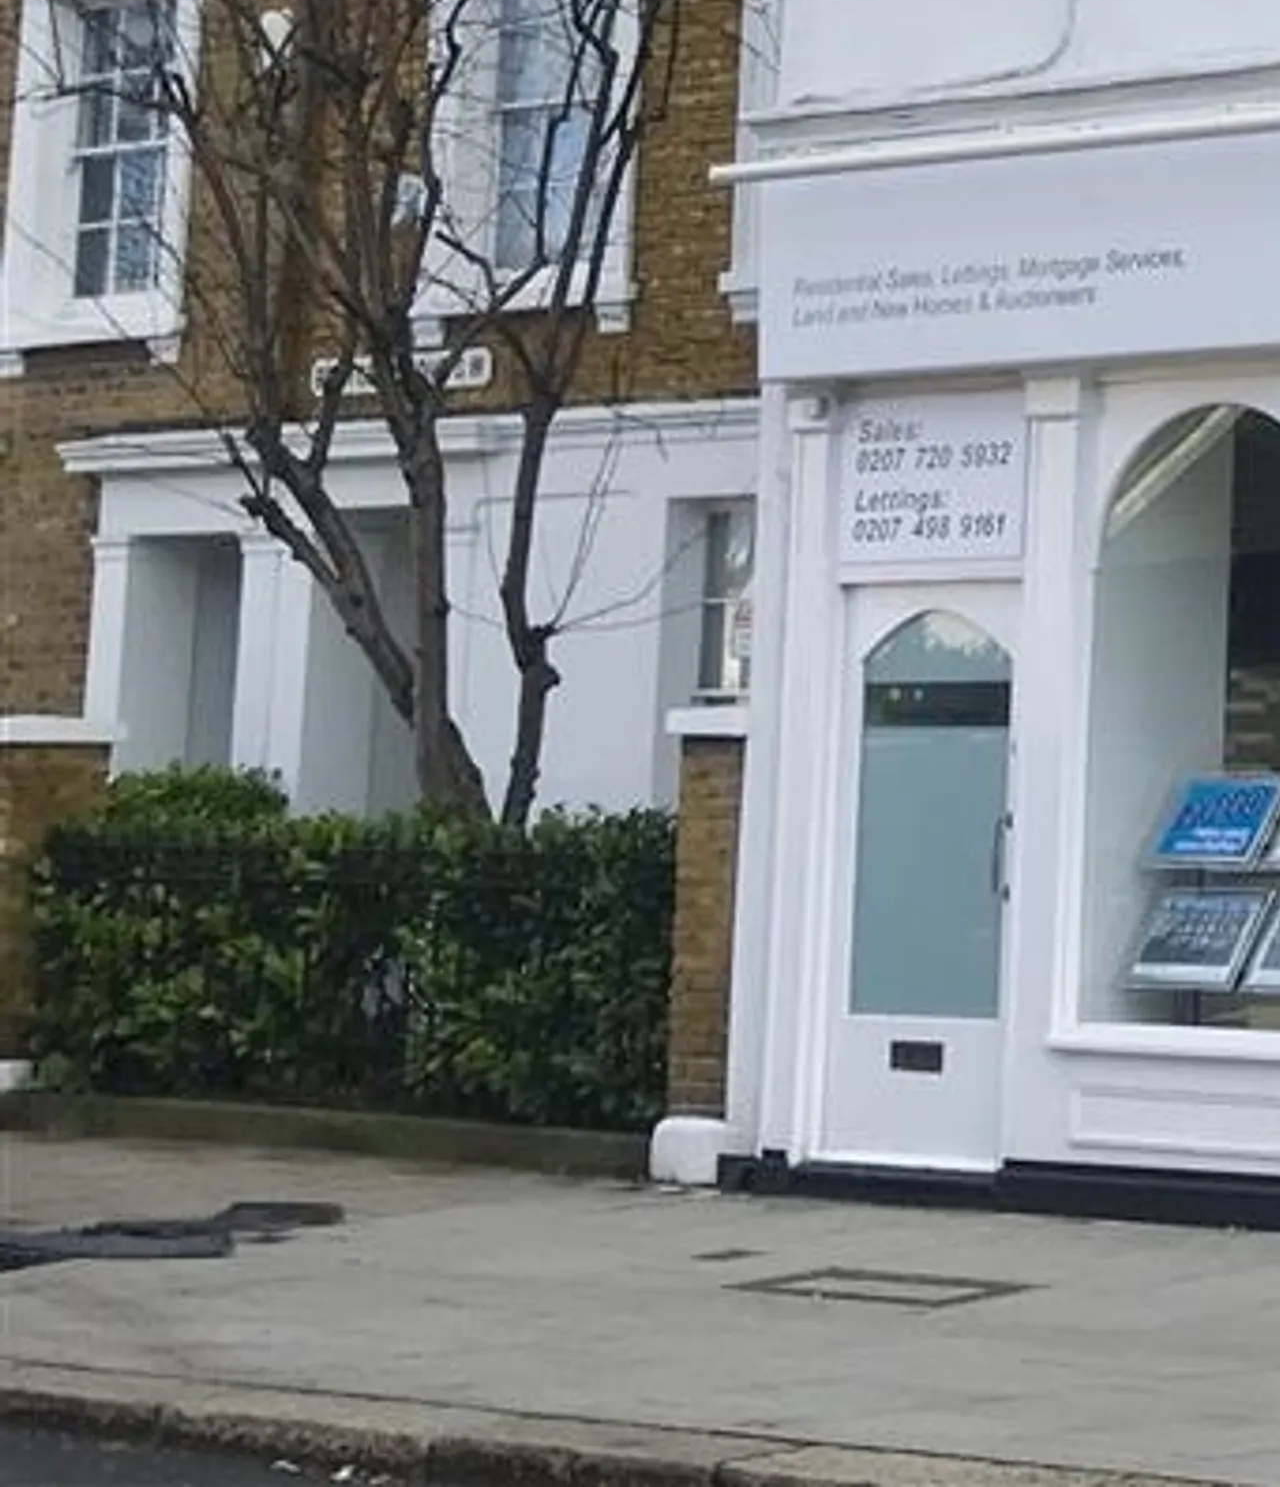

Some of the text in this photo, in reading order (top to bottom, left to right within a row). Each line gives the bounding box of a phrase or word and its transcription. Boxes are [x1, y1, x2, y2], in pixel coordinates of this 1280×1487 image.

[979, 288, 994, 312] &
[855, 446, 907, 475] 0207
[913, 443, 954, 471] 720
[852, 511, 1007, 544] 0207 498 9161
